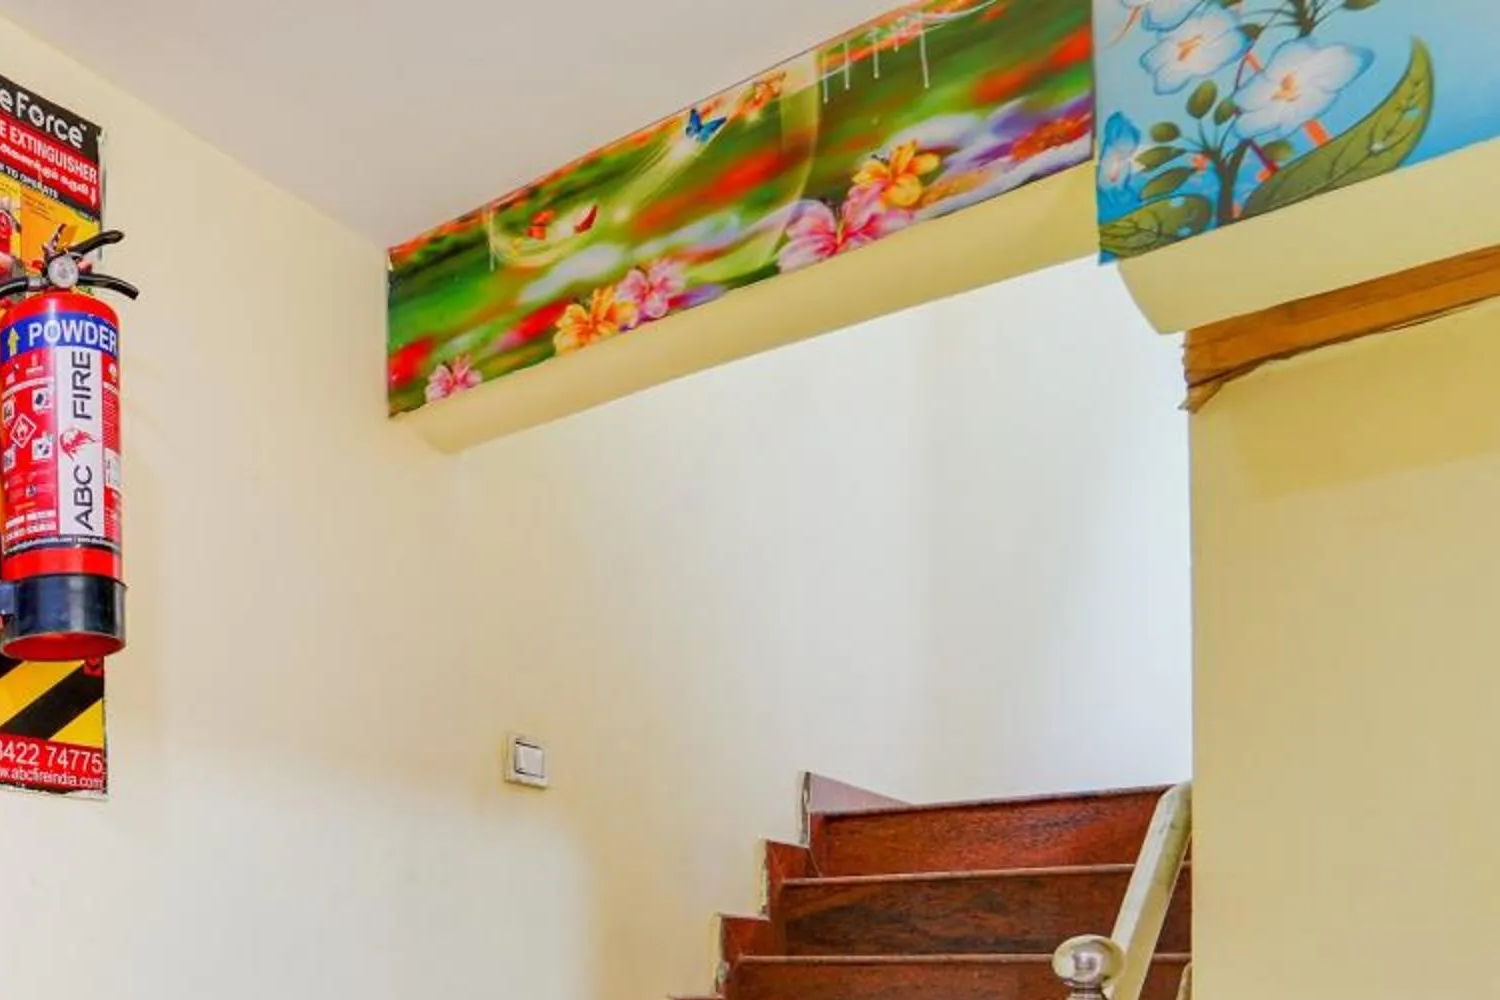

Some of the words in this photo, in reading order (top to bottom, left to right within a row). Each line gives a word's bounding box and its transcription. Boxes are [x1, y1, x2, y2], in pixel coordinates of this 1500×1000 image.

[5, 163, 19, 179] TO
[9, 124, 98, 184] EXTINGUISHER
[28, 319, 117, 355] POWDER
[71, 351, 92, 419] FIRE
[73, 465, 94, 531] ABC
[44, 745, 103, 774] 74775
